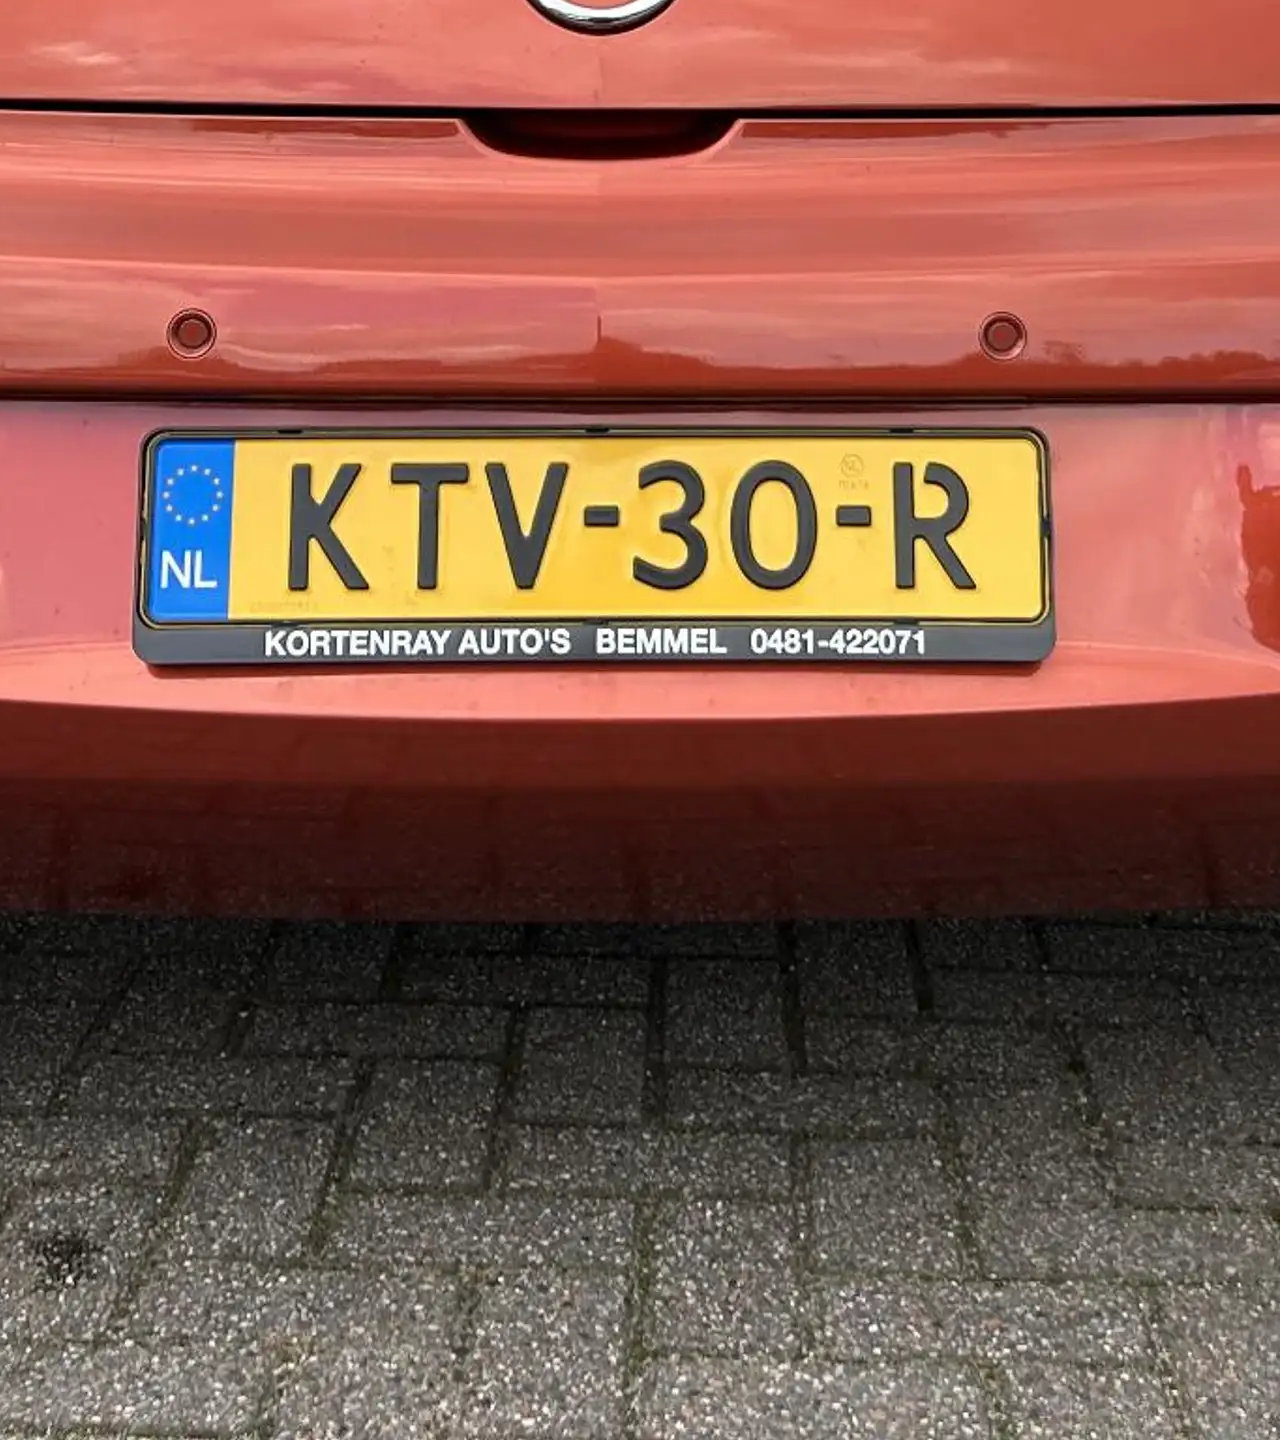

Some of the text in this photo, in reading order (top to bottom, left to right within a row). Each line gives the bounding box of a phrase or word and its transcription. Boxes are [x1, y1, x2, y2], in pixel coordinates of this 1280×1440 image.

[286, 459, 978, 593] KTV-30-R
[161, 551, 218, 588] NL
[264, 627, 926, 657] KORTENRAY AUTO'S BEMMEL 0481-422071
